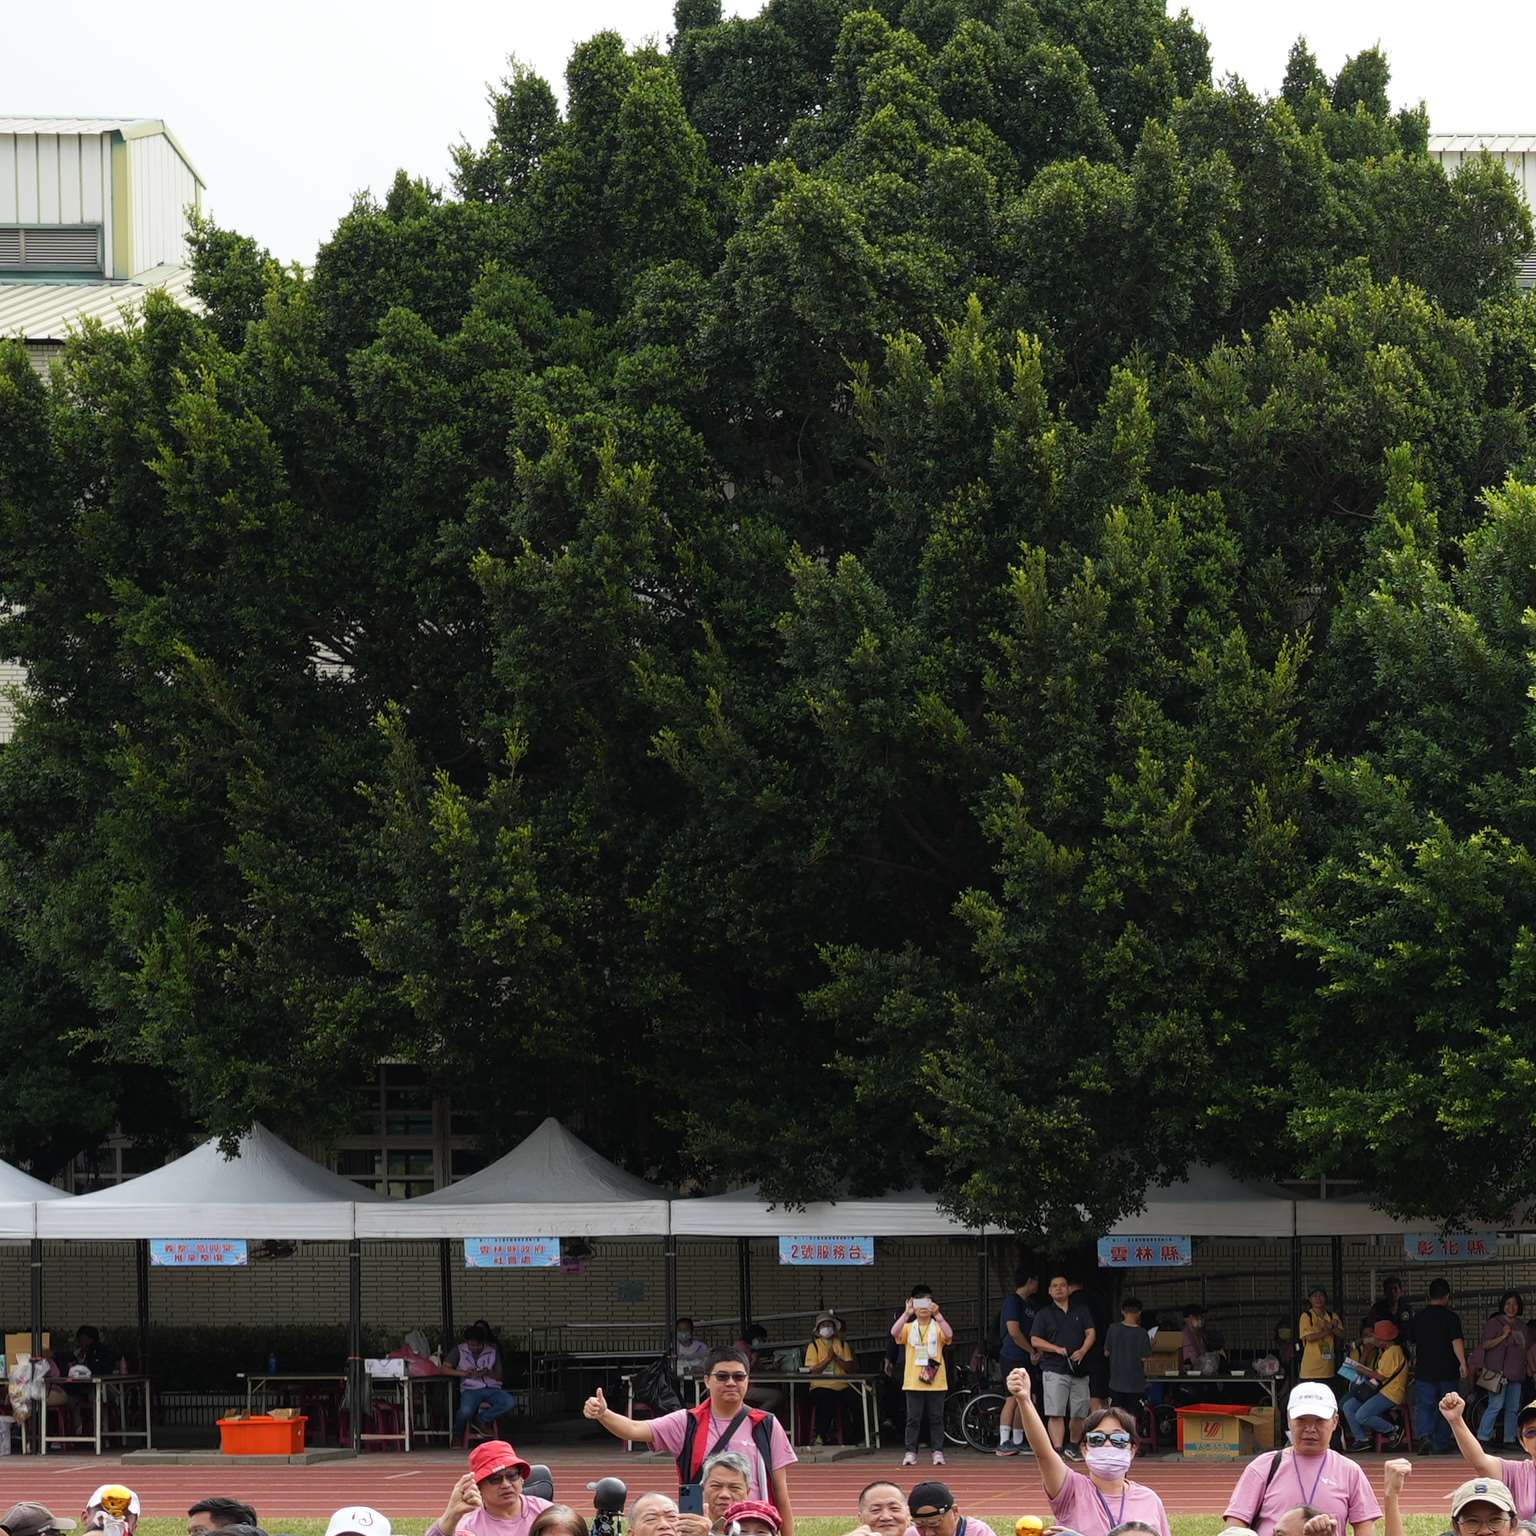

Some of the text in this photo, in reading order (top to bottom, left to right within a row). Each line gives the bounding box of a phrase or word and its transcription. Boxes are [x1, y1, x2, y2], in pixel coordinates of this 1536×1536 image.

[791, 1244, 861, 1260] 2號服務台
[1111, 1245, 1180, 1262] 雲林縣
